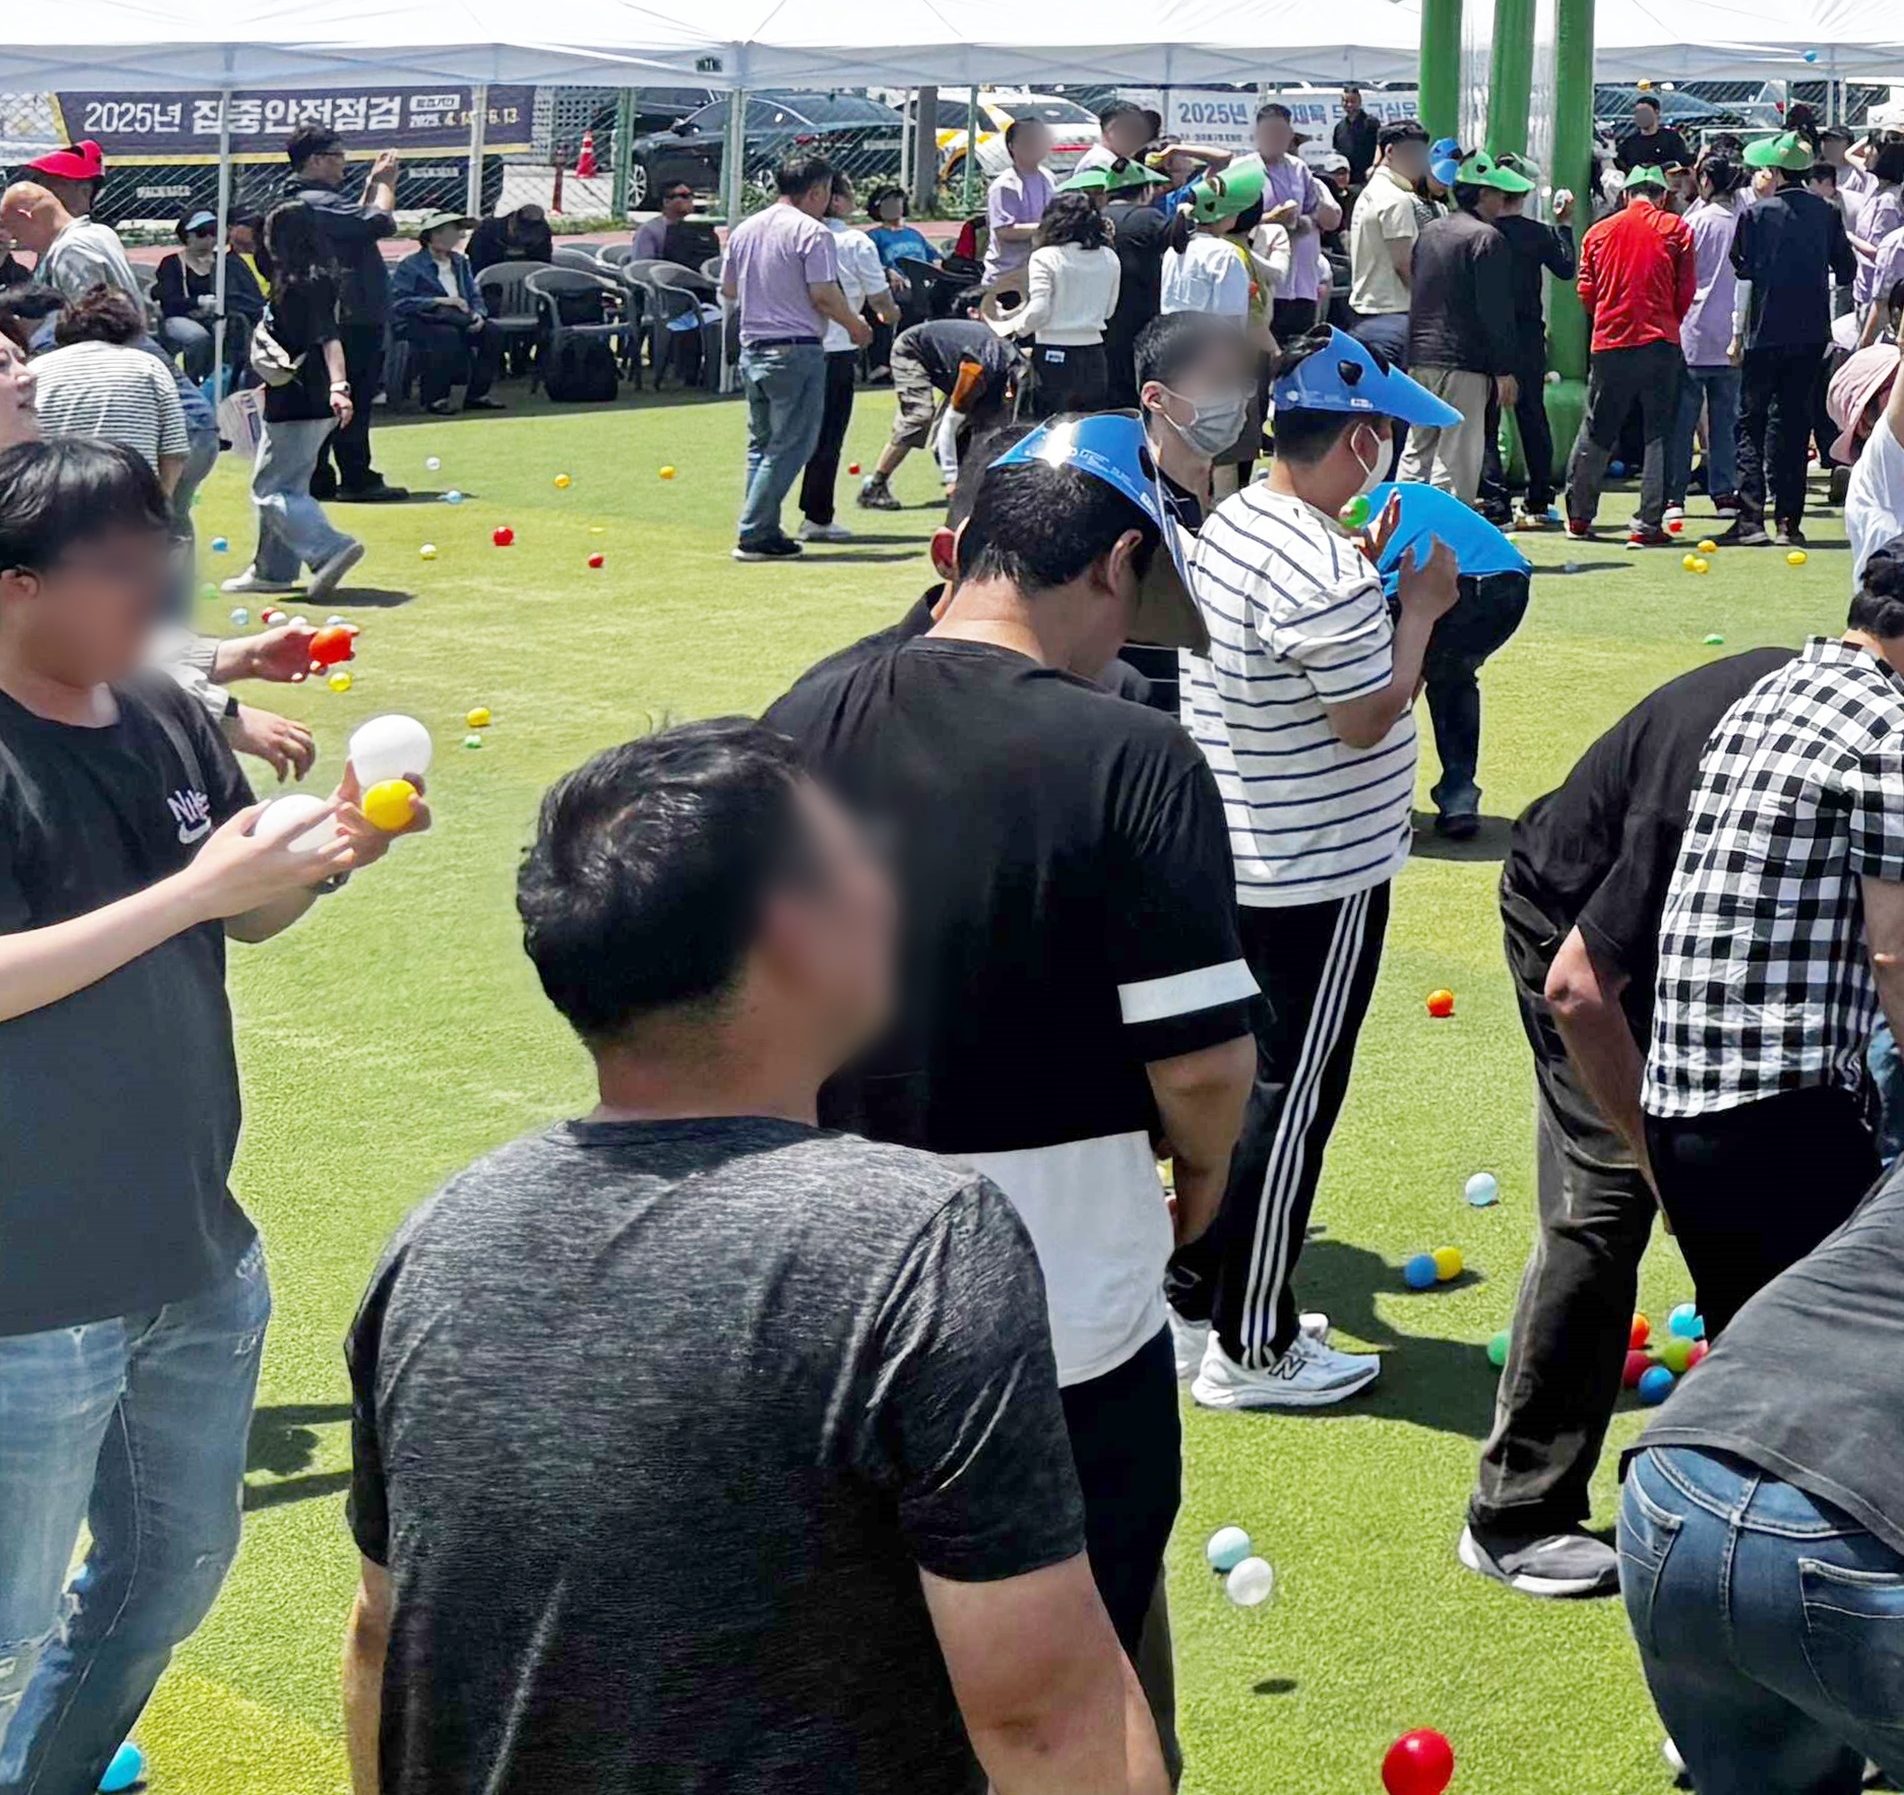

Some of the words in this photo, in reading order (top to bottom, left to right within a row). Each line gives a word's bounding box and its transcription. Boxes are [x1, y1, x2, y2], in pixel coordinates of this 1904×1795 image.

[83, 102, 181, 134] 2025년
[192, 96, 402, 135] 집중안전점검
[1179, 102, 1250, 126] 2025년
